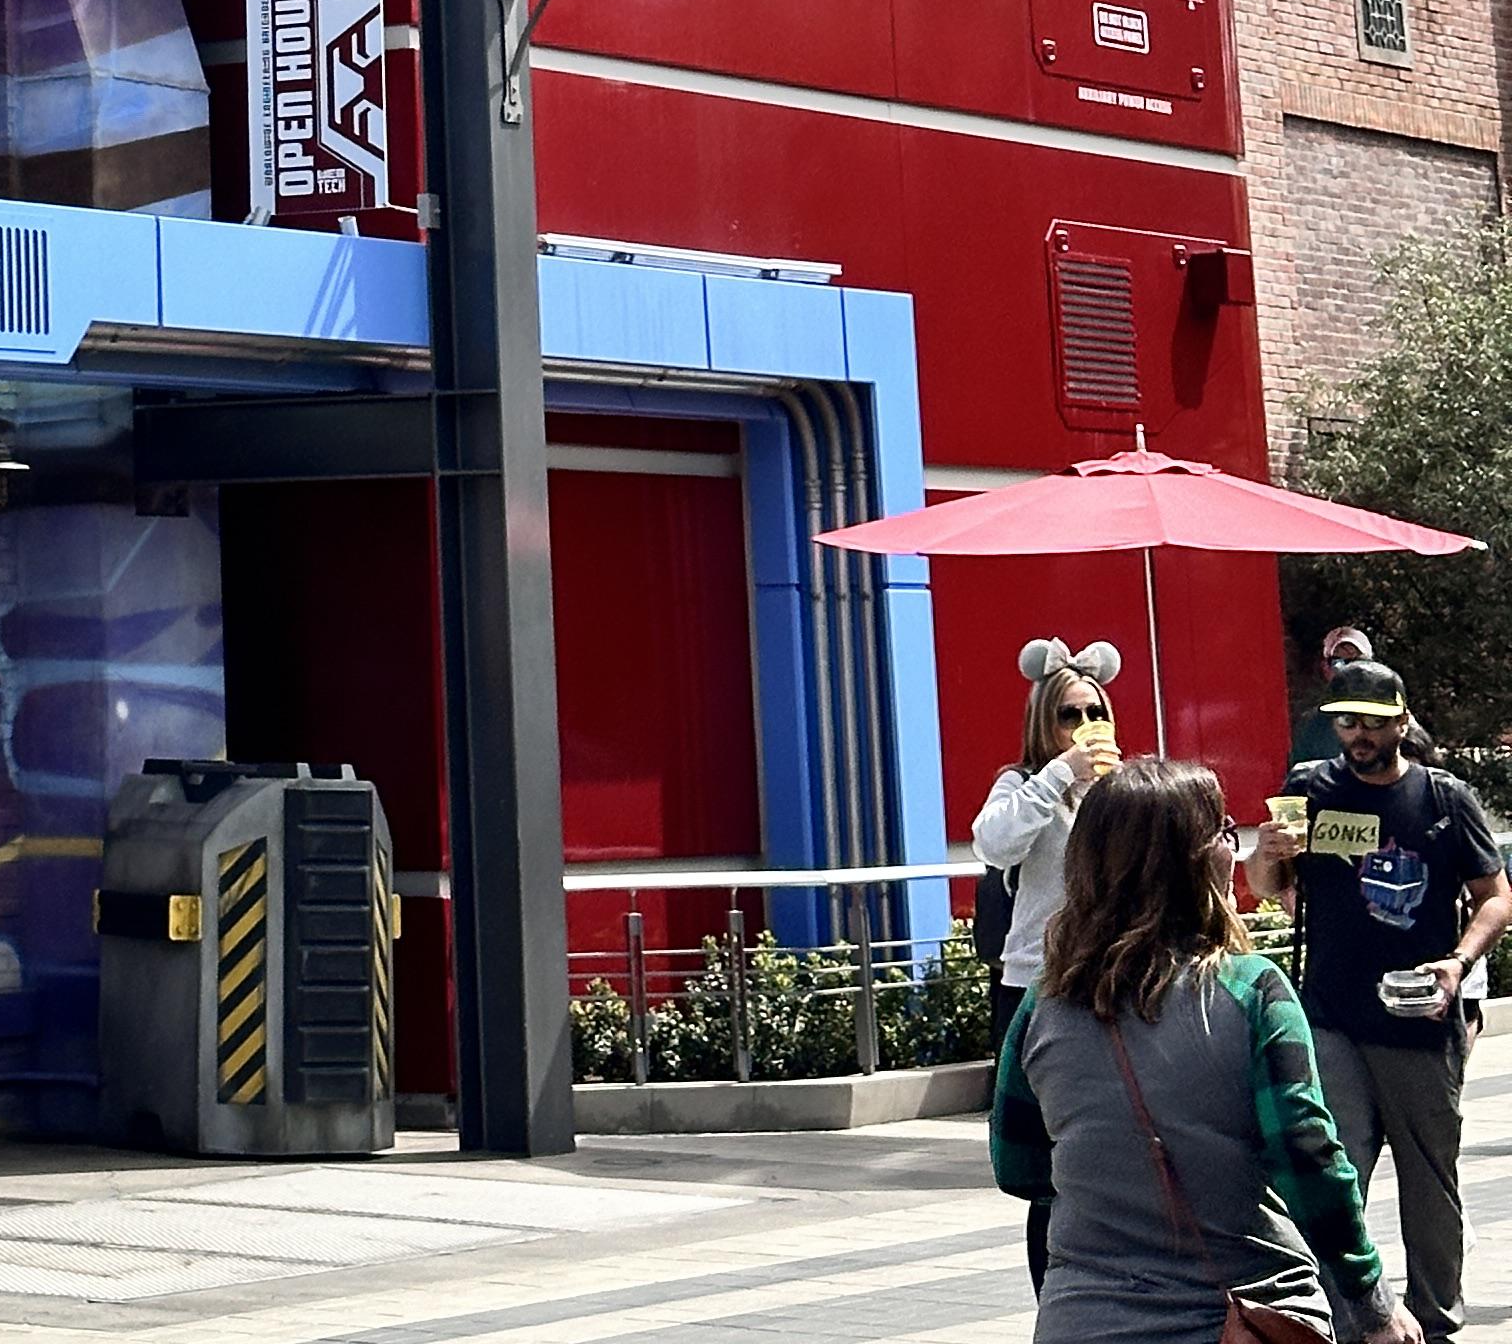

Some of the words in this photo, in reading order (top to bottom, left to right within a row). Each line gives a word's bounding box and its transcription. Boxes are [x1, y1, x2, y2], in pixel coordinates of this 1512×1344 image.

[278, 91, 314, 196] OPEN
[317, 179, 345, 193] TECH
[1315, 822, 1376, 843] GONK!
